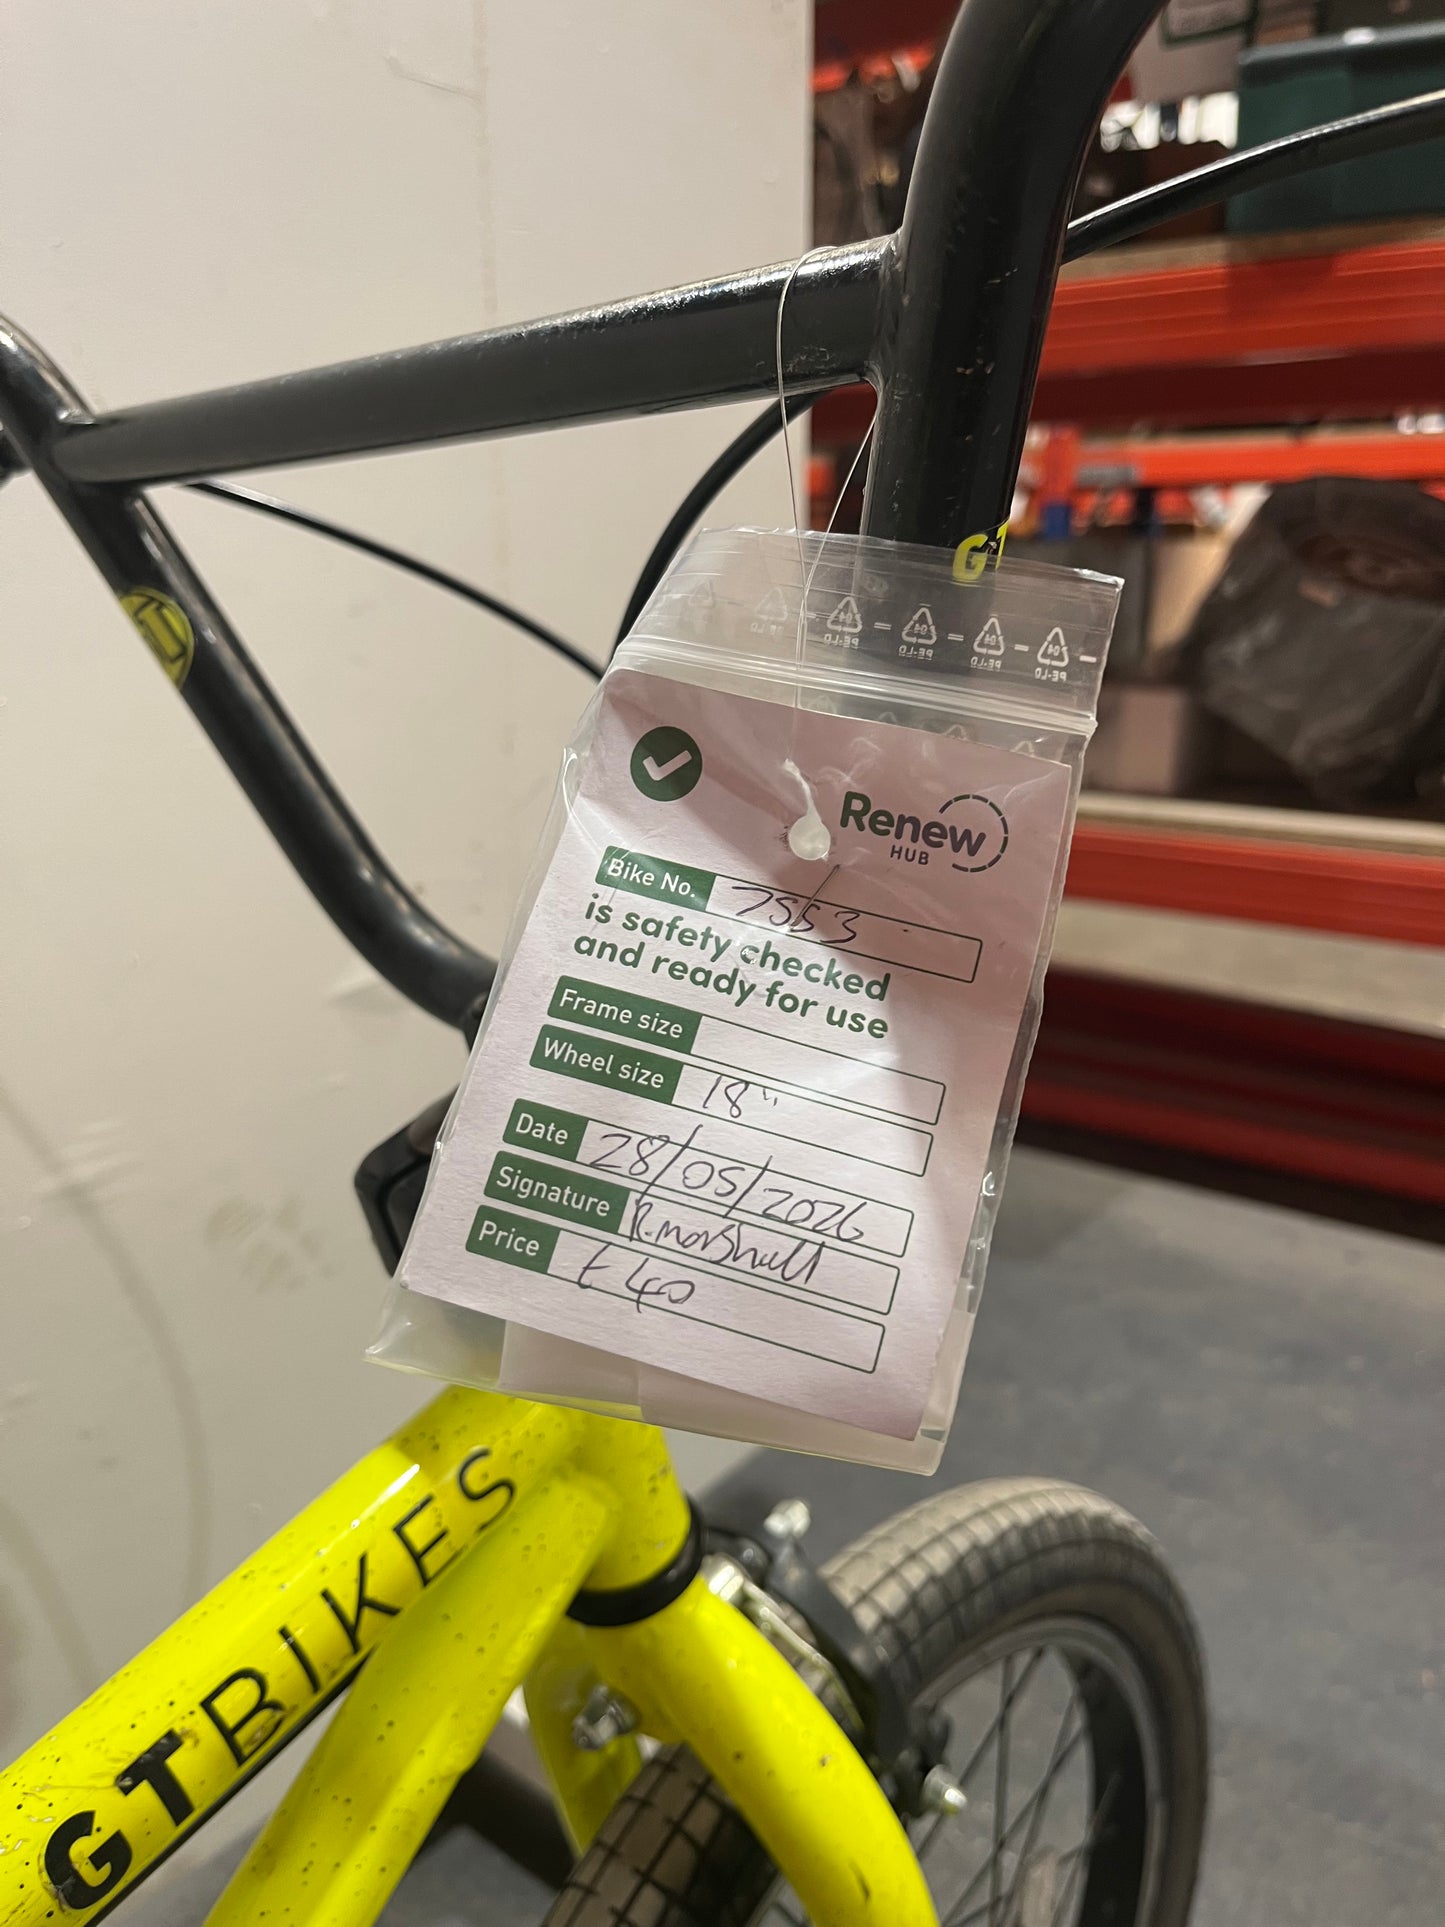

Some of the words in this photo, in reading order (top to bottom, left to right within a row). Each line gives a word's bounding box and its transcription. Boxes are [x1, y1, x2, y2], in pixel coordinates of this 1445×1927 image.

[840, 791, 987, 857] Renew
[608, 857, 655, 886] Bike
[661, 872, 696, 898] No.
[890, 845, 930, 867] HUB
[584, 892, 612, 924] is
[621, 912, 731, 963] safety
[739, 940, 891, 1002] checked
[574, 931, 646, 969] and
[653, 954, 756, 1007] ready
[765, 980, 819, 1019] for
[825, 1003, 889, 1039] use
[559, 988, 632, 1024] Frame
[637, 1012, 684, 1039] size
[542, 1037, 612, 1076] Wheel
[618, 1060, 664, 1089] size
[516, 1112, 568, 1146] Date
[496, 1165, 610, 1218] Signature
[589, 1124, 867, 1242] 28/05/2026
[478, 1220, 540, 1256] Price
